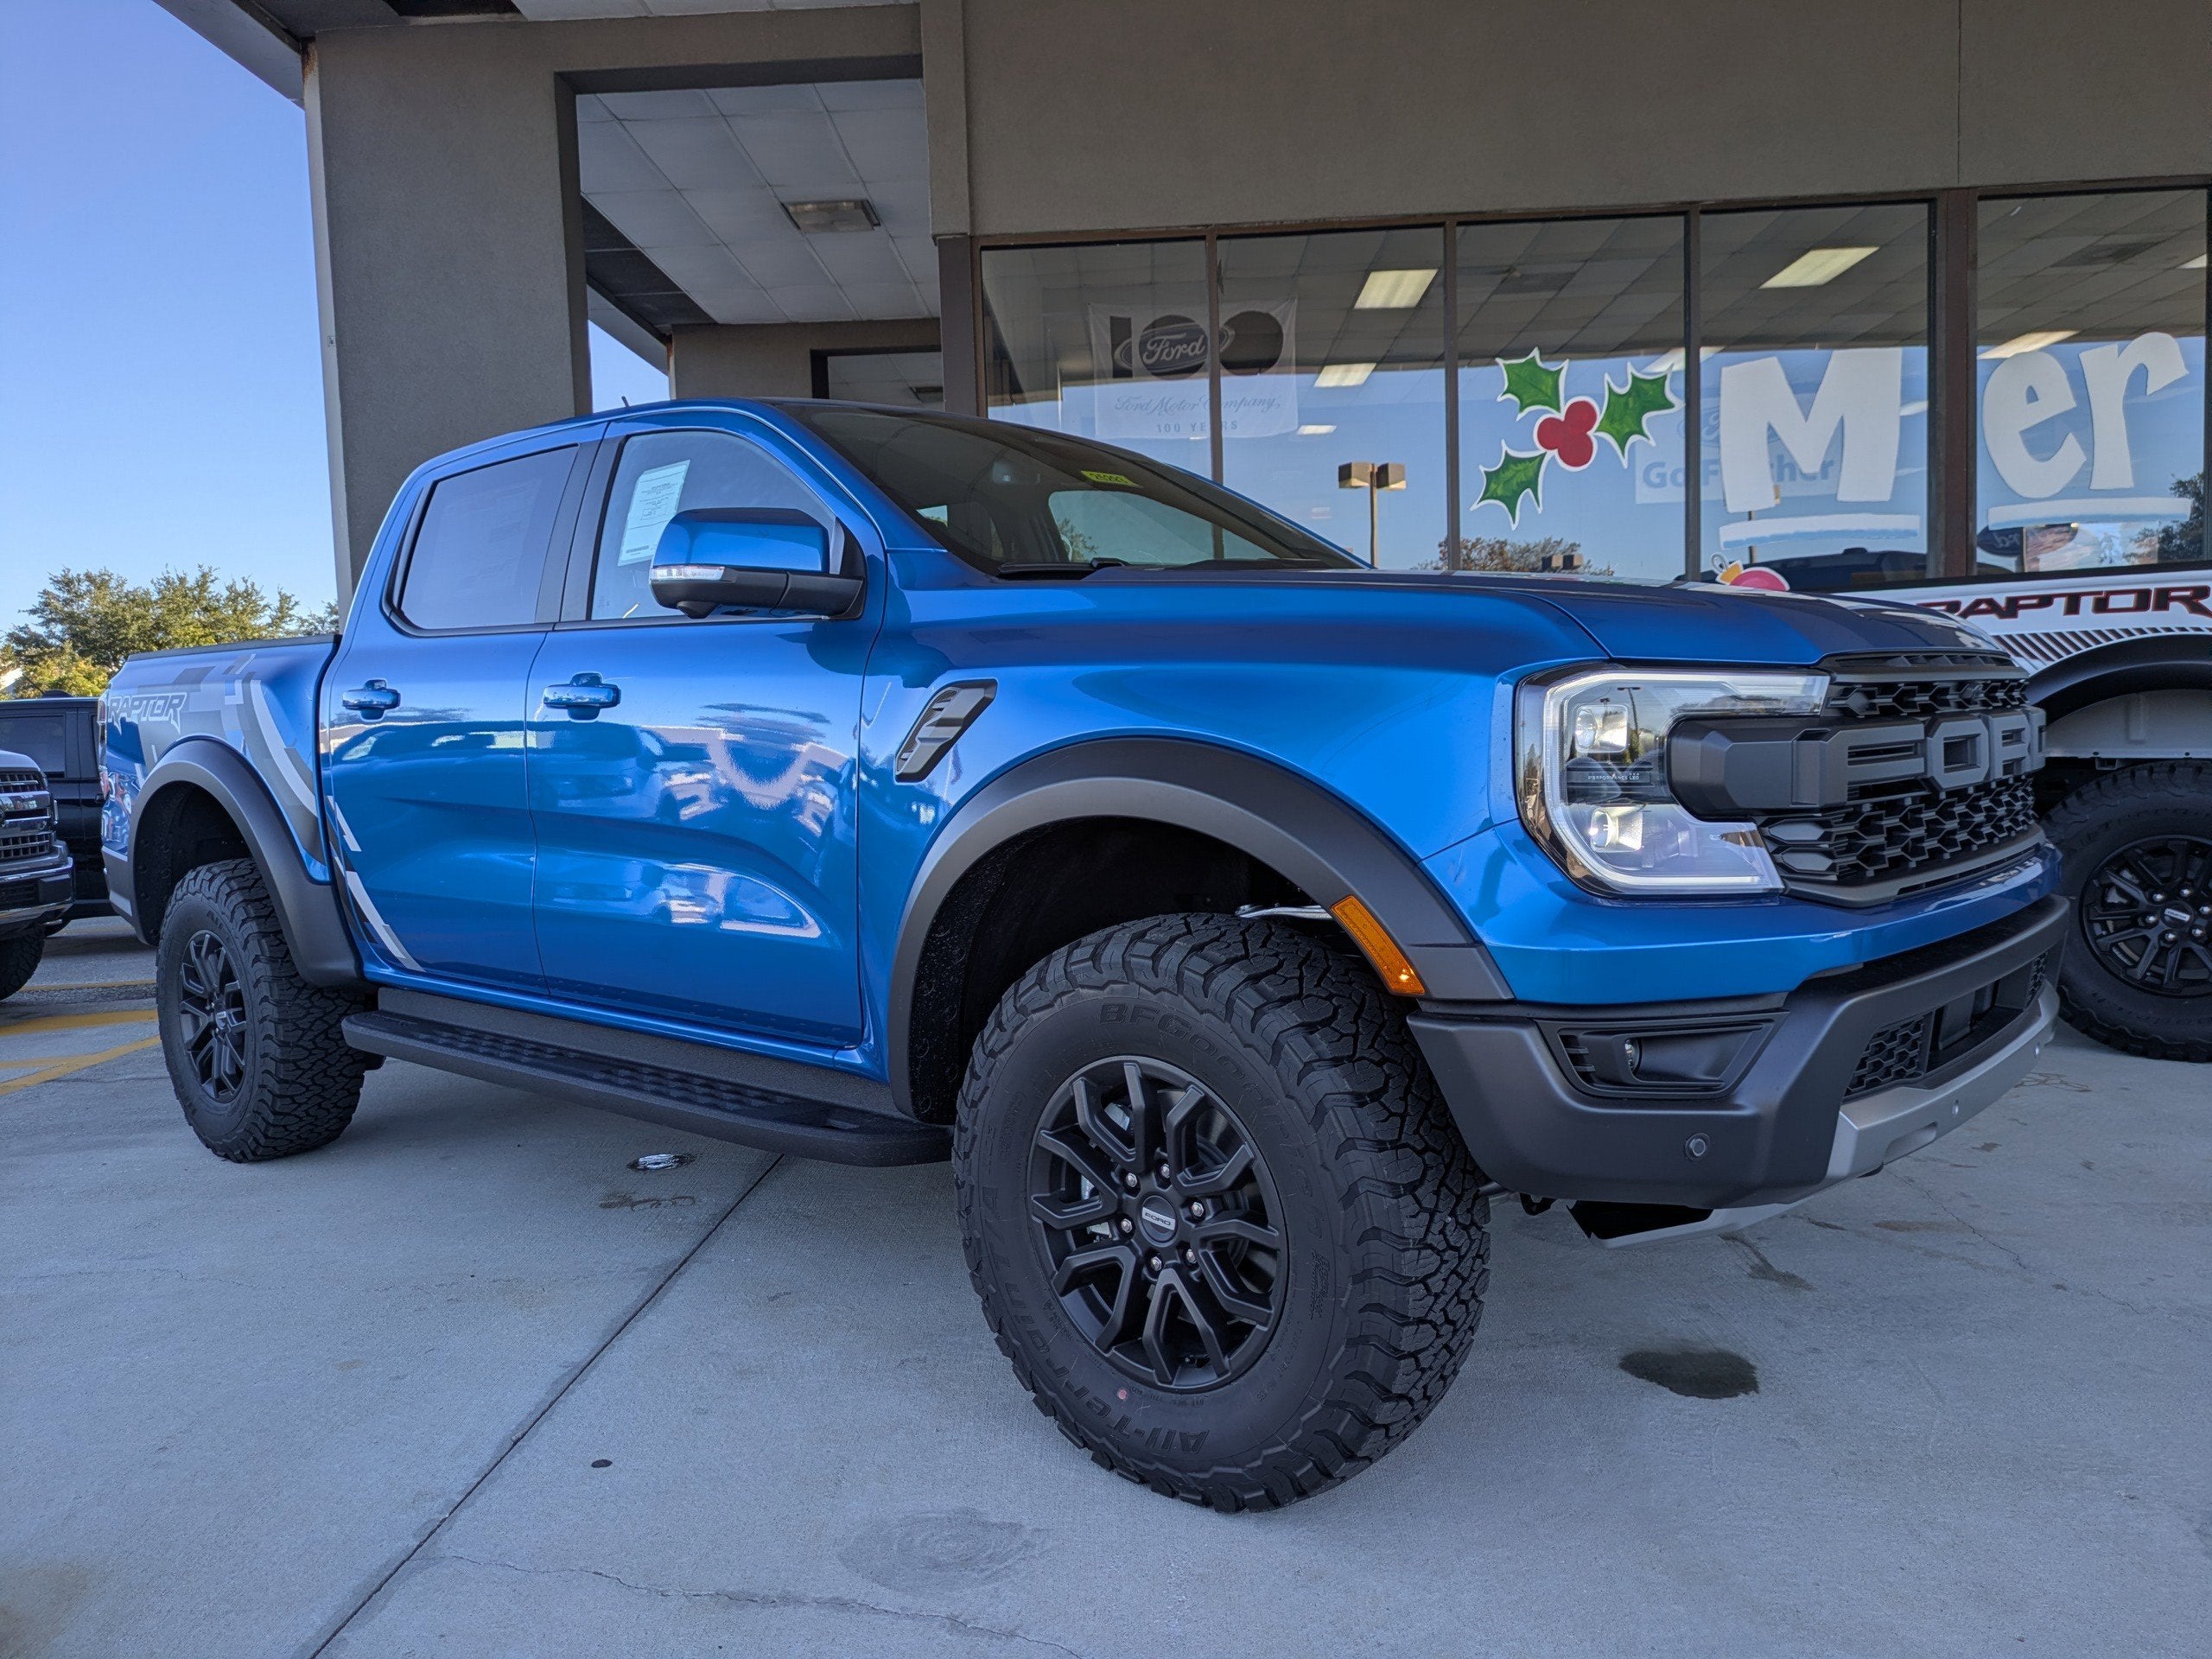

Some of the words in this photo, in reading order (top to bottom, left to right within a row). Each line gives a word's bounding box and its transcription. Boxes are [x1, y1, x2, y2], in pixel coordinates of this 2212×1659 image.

[1141, 333, 1206, 365] Ford
[1114, 395, 1154, 411] Ford
[1148, 396, 1200, 416] Motor
[1156, 423, 1181, 434] 100
[107, 692, 188, 735] RAPTOR
[1145, 1212, 1171, 1226] FORD
